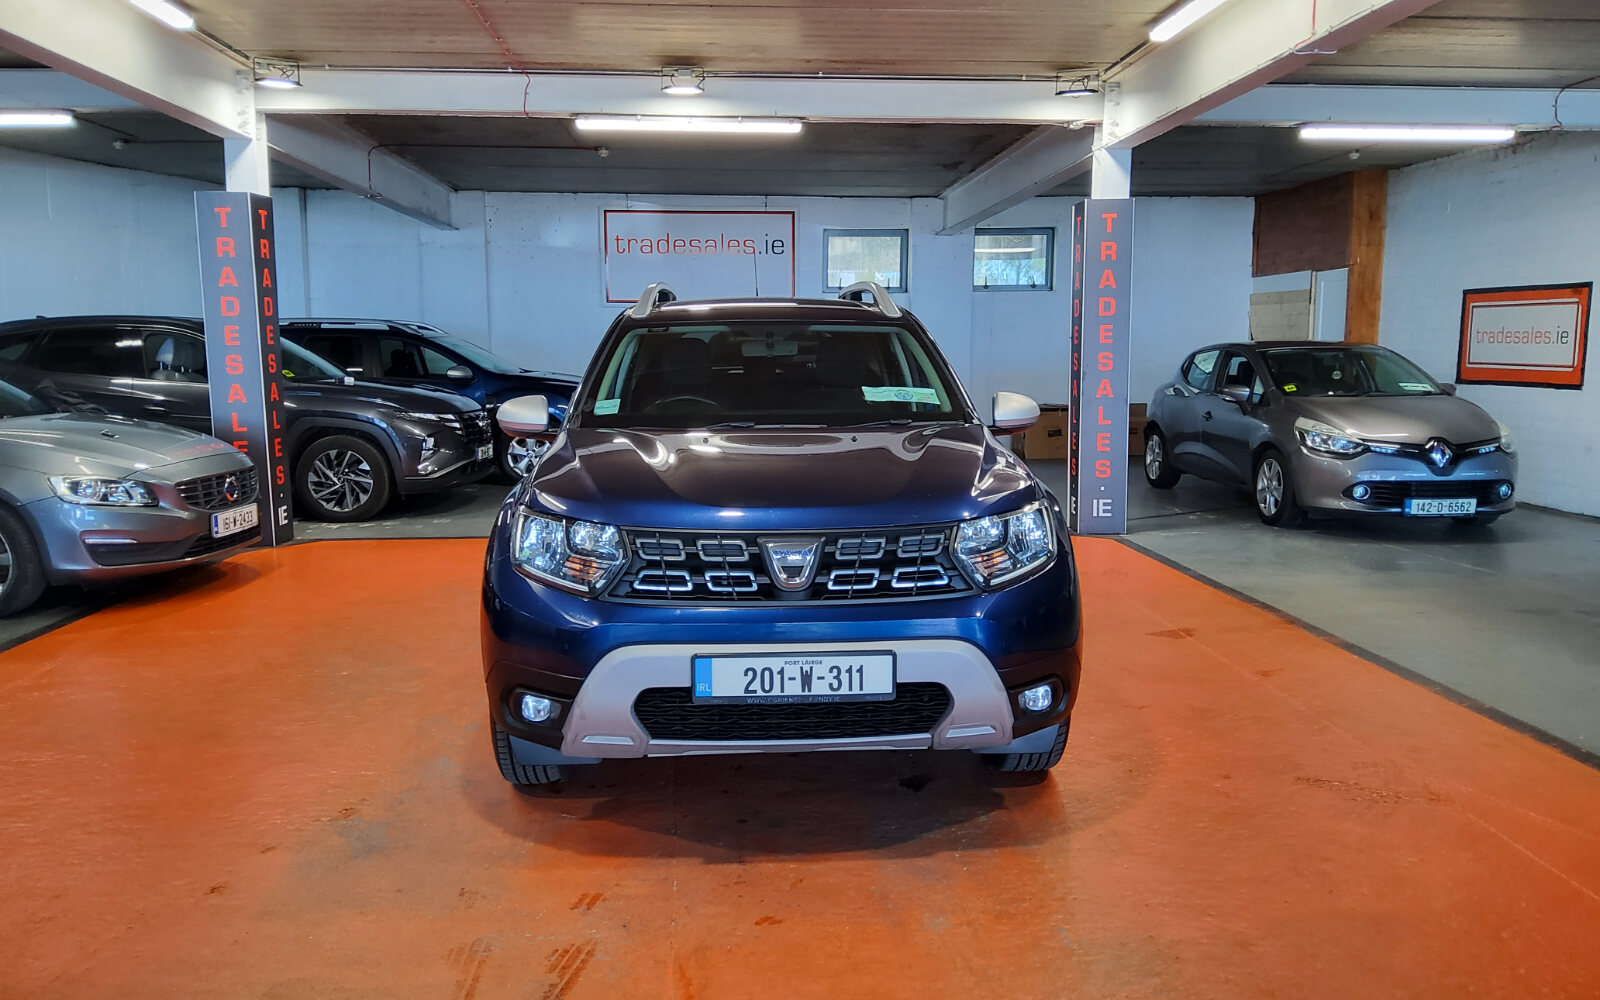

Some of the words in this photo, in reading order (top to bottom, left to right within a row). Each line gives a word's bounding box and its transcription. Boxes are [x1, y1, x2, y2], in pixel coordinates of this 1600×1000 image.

[614, 232, 785, 255] tradesales.ie
[1476, 325, 1569, 345] tradesales.ie
[1416, 501, 1472, 513] 142-D-6562
[696, 683, 711, 692] IRL
[743, 664, 864, 695] 201-W-311
